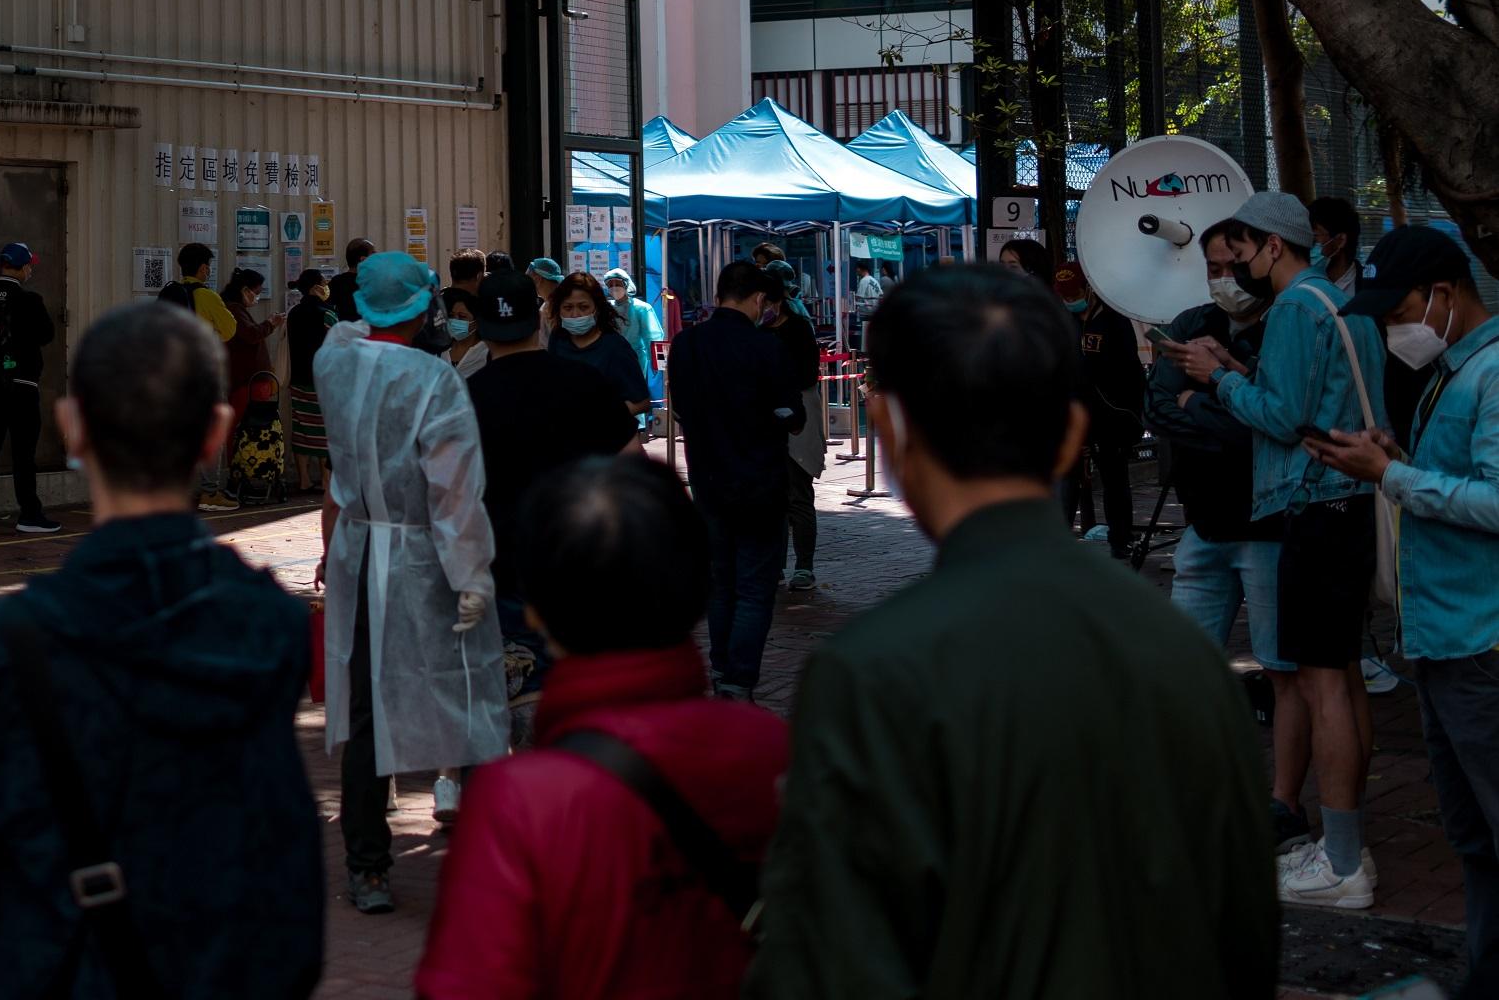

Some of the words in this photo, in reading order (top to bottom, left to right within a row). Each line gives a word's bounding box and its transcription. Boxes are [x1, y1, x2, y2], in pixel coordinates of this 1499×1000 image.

[155, 151, 319, 189] 指定區域免費檢測
[1007, 201, 1021, 222] 9
[496, 297, 513, 317] LA
